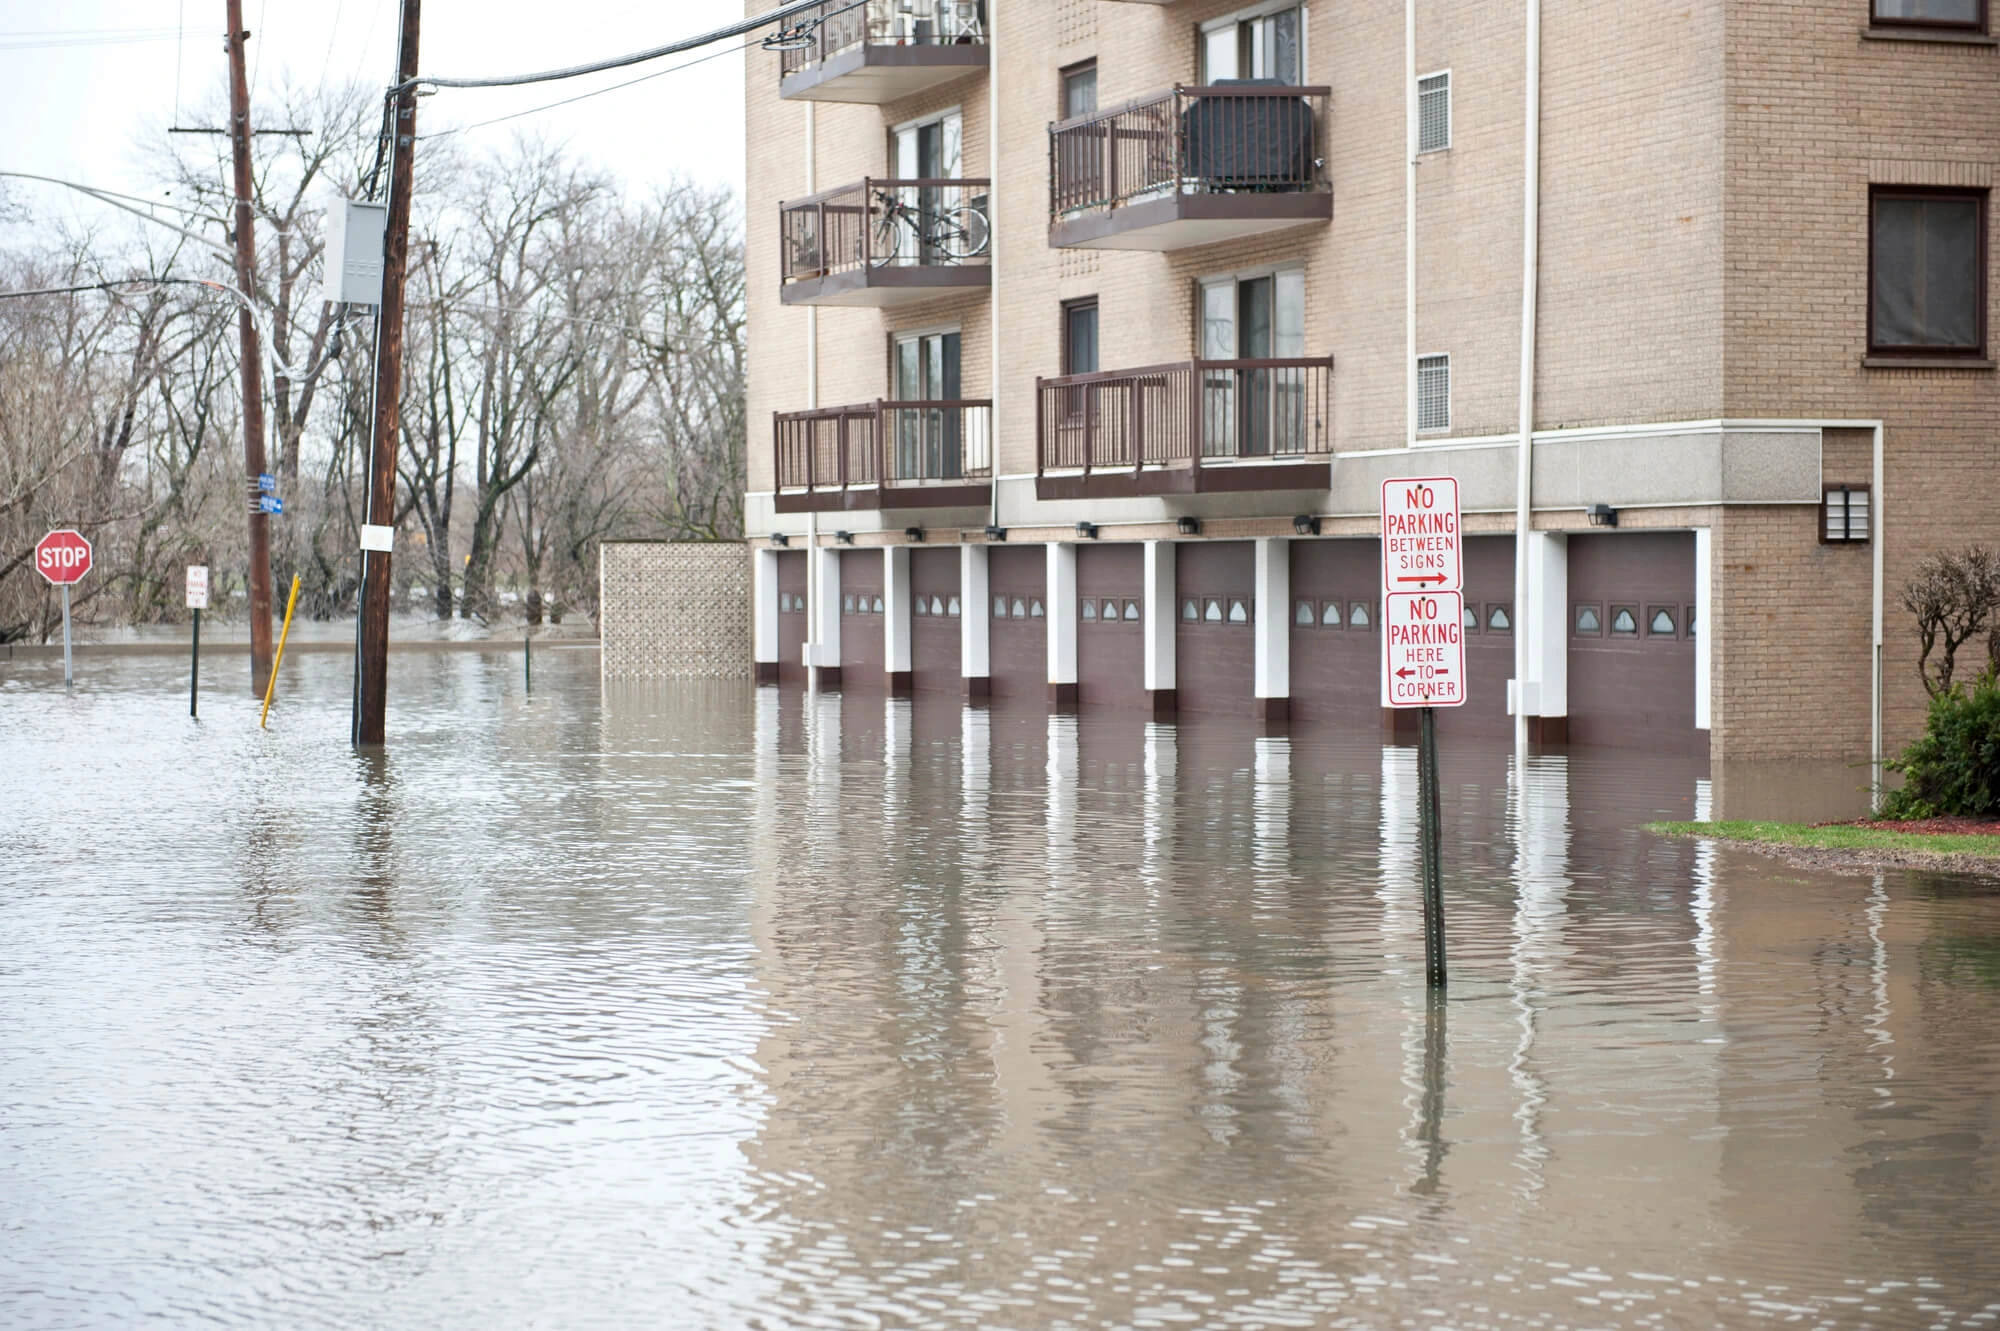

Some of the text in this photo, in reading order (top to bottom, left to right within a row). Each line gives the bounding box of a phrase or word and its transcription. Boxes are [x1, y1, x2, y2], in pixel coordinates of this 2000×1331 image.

[1406, 487, 1434, 509] NO
[1388, 512, 1454, 535] PARKING
[1390, 536, 1454, 553] BETWEEN
[41, 546, 87, 568] STOP
[1400, 554, 1445, 569] SIGNS
[1410, 599, 1438, 620] NO
[1391, 623, 1458, 645] PARKING
[1406, 648, 1444, 662] HERE
[1418, 665, 1434, 679] TO
[1397, 681, 1455, 697] CORNER
